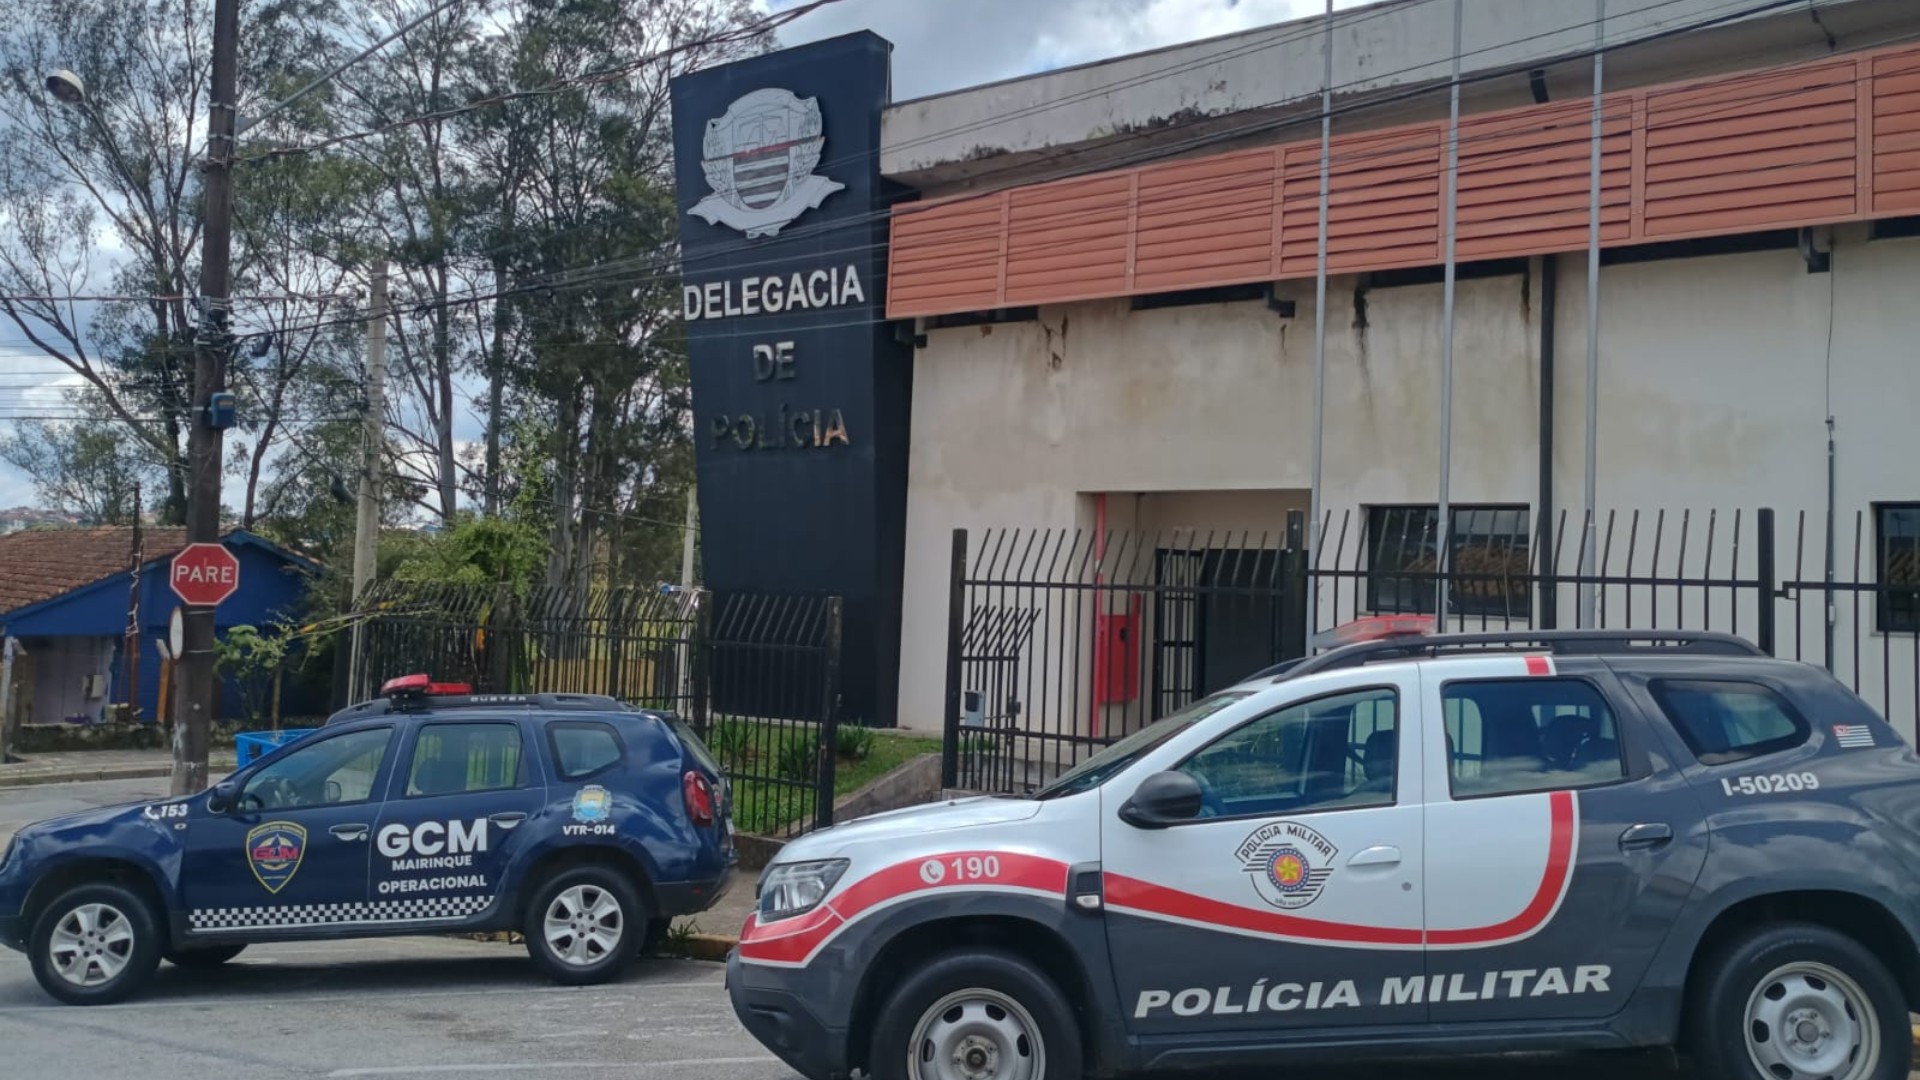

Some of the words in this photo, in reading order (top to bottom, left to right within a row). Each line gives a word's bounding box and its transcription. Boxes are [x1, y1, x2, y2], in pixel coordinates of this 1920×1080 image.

[683, 264, 865, 321] DELEGACIA
[753, 340, 796, 381] DE
[710, 402, 849, 449] POLÍCIA
[176, 565, 234, 583] PARE
[1721, 771, 1820, 797] I-50209
[161, 803, 188, 818] 153
[377, 818, 488, 857] GCM
[563, 824, 616, 836] VTR-014
[1287, 825, 1331, 857] MILITAR
[391, 855, 473, 871] MAIRINQUE
[951, 855, 1000, 880] 190
[378, 874, 488, 894] OPERACIONAL
[1134, 978, 1362, 1018] POLÍCIA
[1379, 964, 1612, 1006] MILITAR
